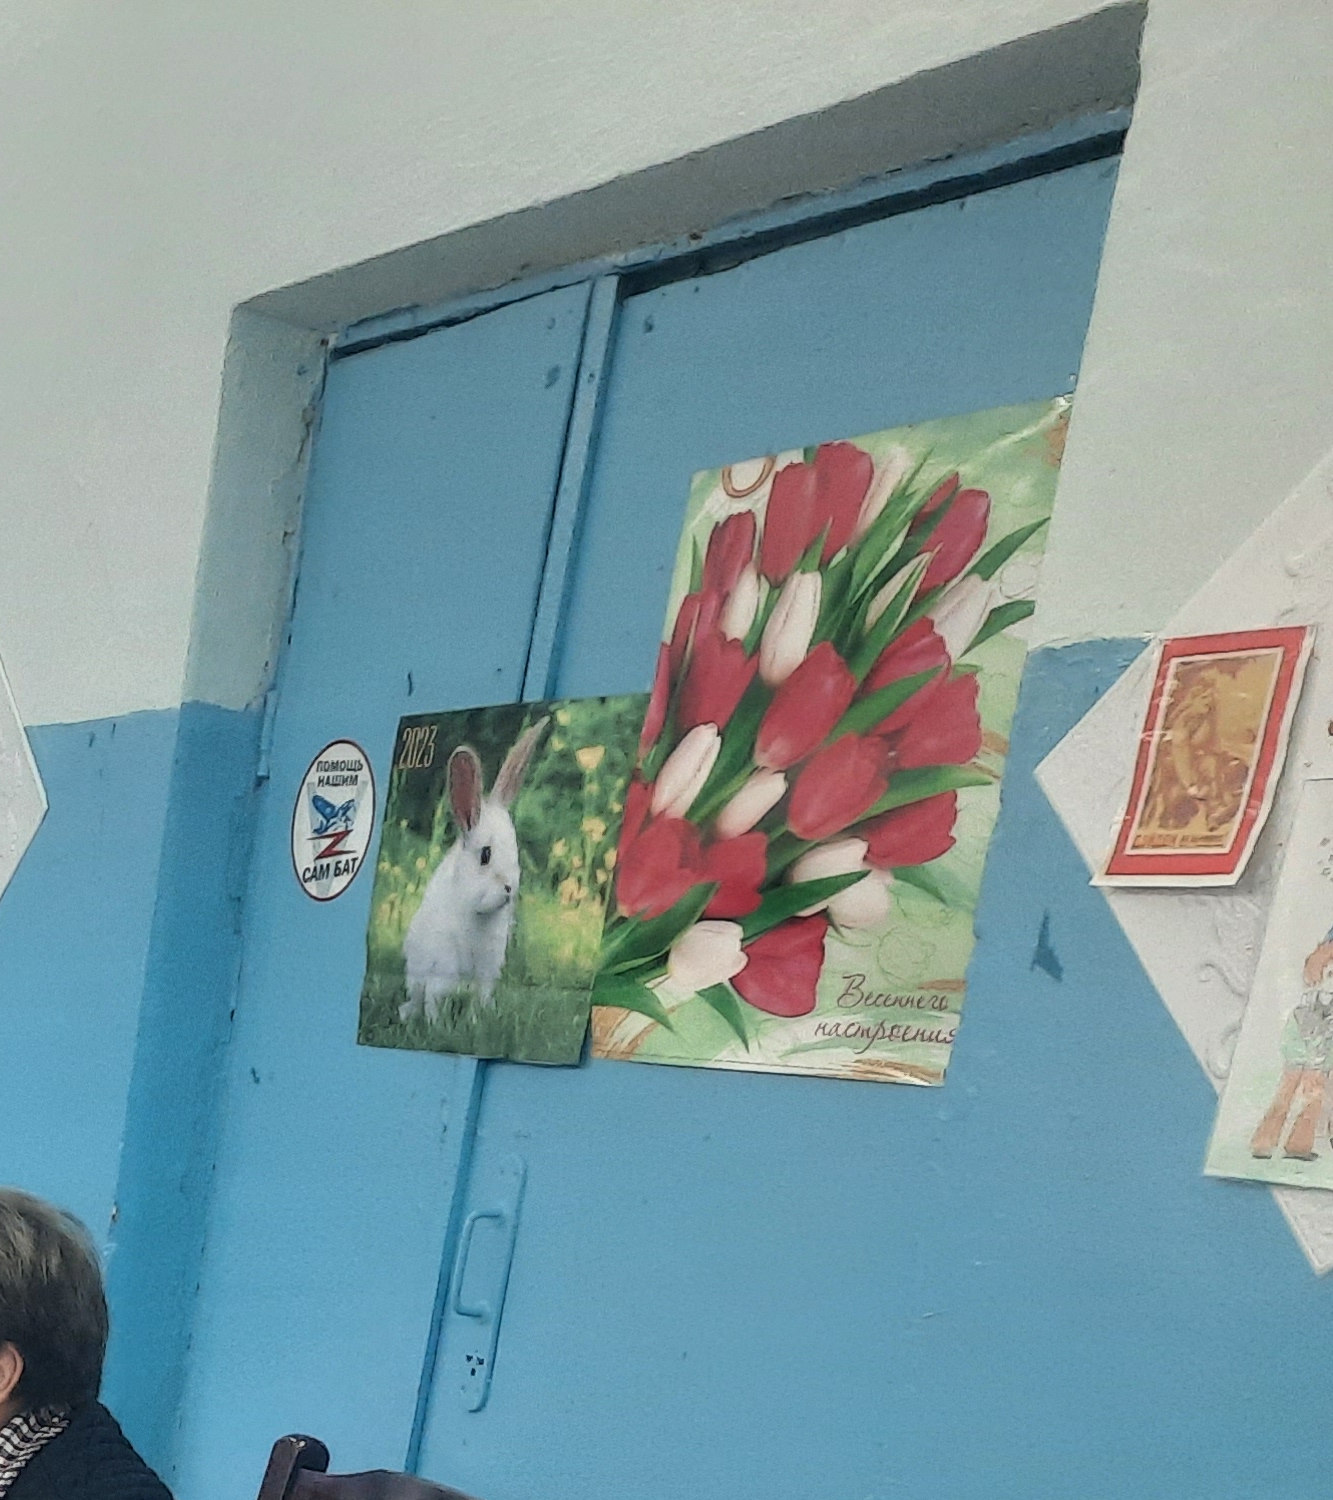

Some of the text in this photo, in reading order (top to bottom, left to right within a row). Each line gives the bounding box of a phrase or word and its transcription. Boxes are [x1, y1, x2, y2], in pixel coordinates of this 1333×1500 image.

[398, 725, 438, 769] 2023
[316, 759, 364, 773] ПОМОЩЬ
[317, 774, 359, 788] НАШИМ
[302, 857, 359, 884] САМ БАТ
[836, 973, 949, 1011] Весеннего
